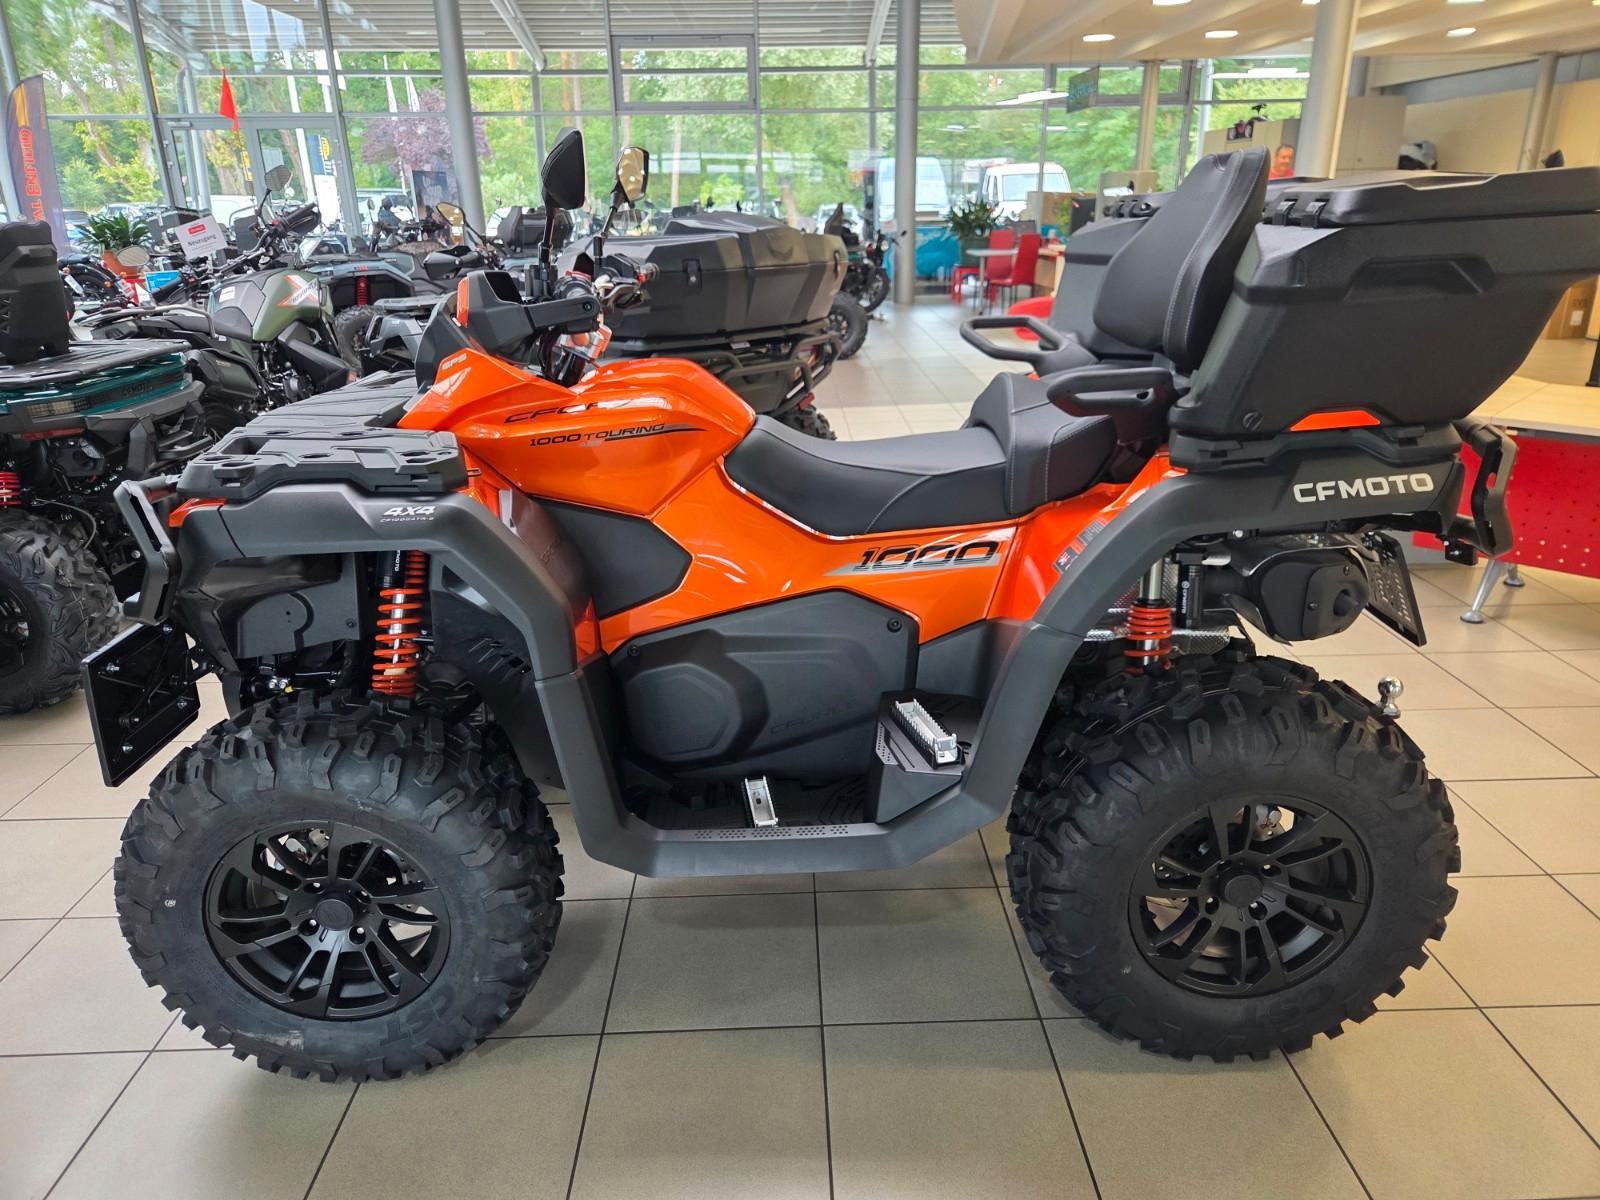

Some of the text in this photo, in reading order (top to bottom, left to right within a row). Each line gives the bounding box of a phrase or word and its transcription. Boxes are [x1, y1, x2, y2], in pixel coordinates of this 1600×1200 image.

[529, 423, 665, 447] 1000 TOURING
[1293, 472, 1434, 503] CFMOTO
[852, 541, 1001, 572] 1000
